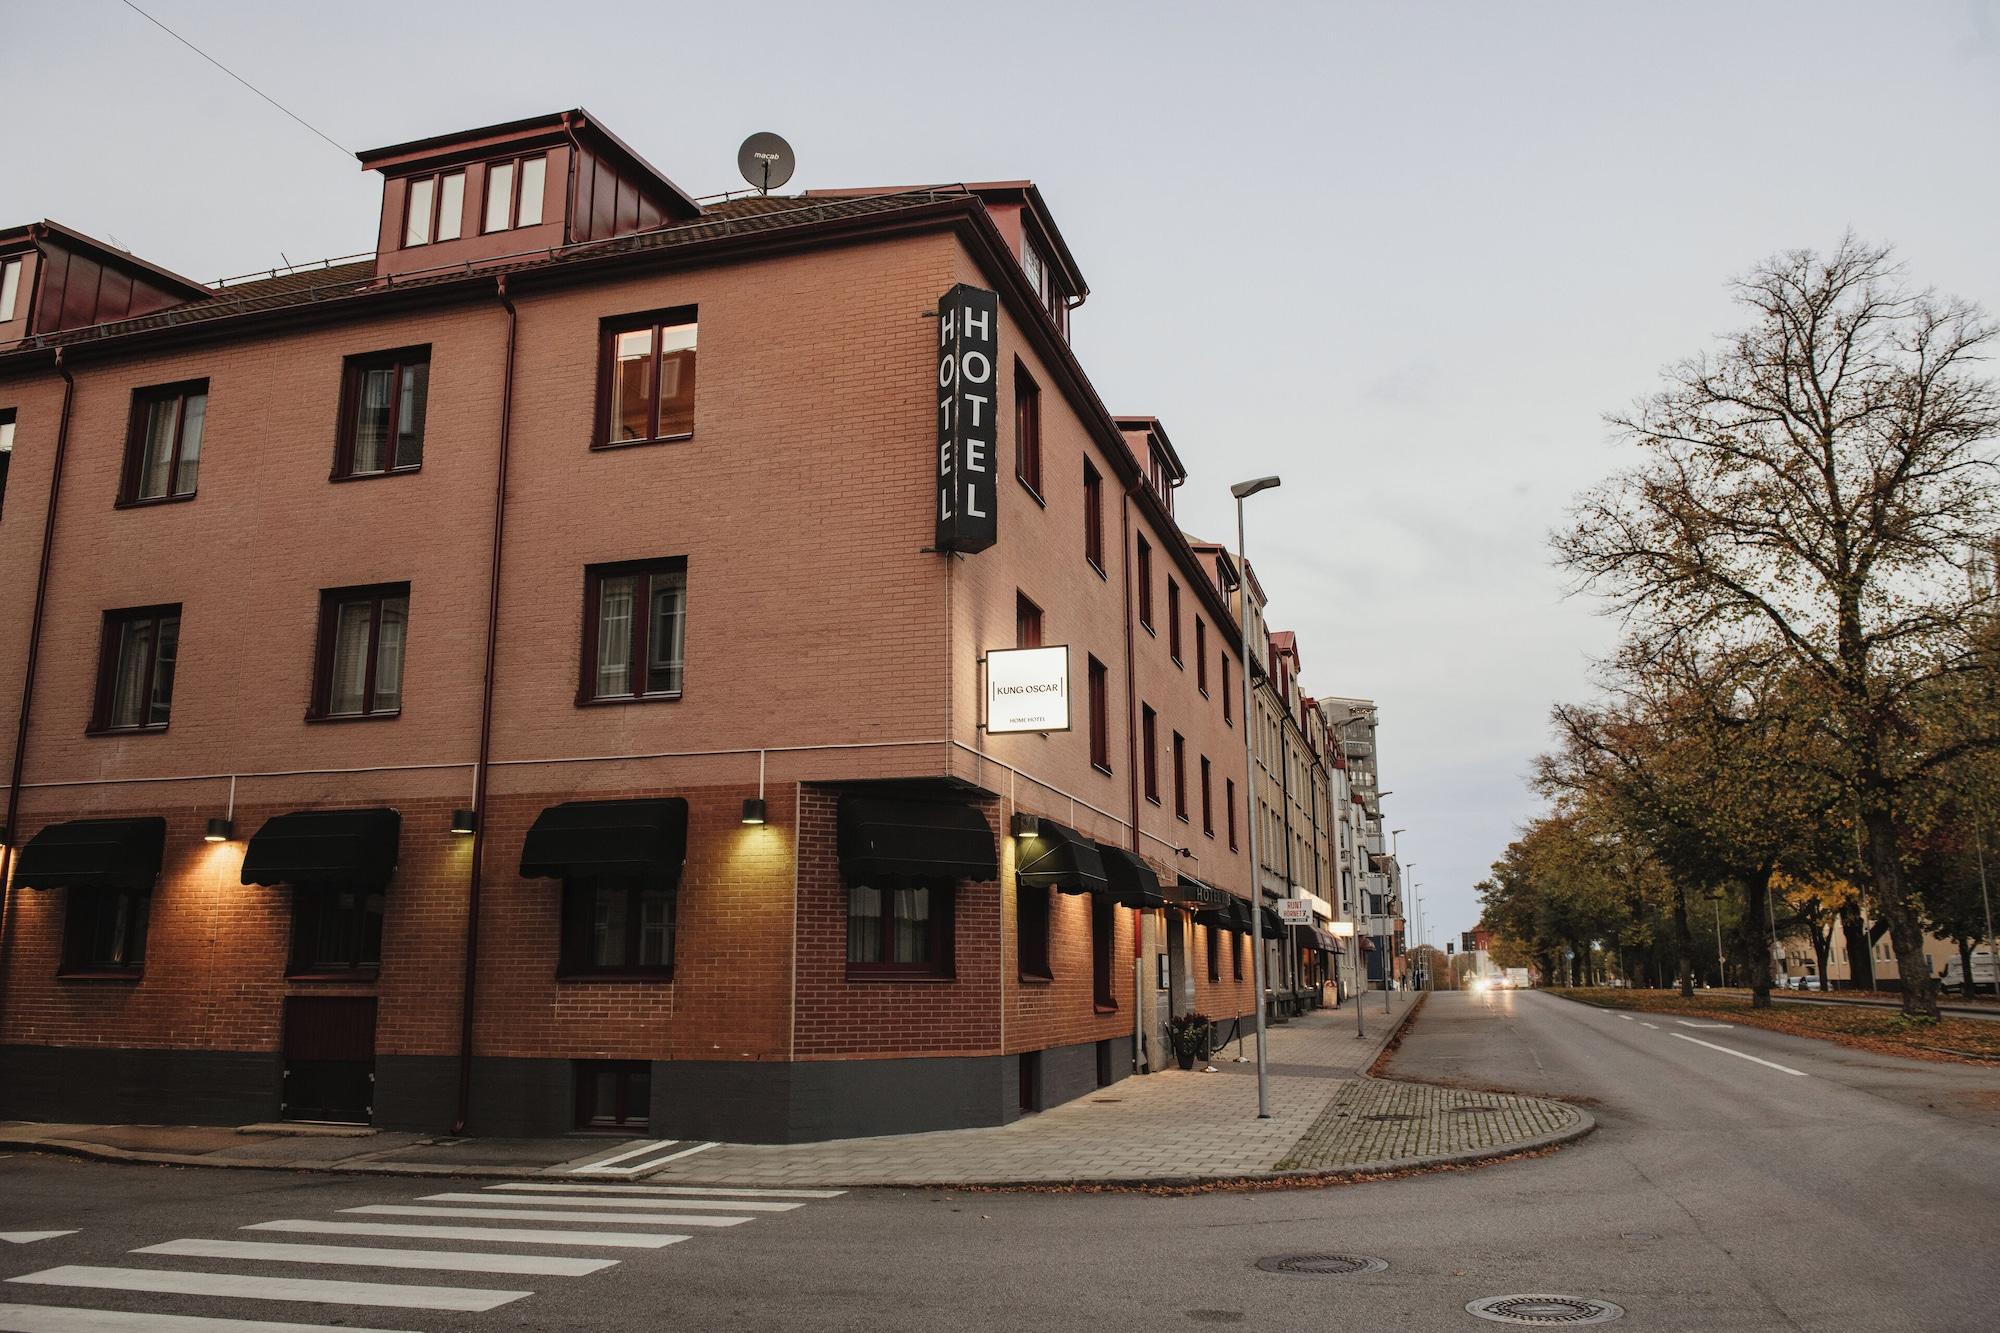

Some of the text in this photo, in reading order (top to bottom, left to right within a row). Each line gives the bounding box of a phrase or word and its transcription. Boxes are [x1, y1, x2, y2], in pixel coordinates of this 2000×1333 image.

[754, 152, 779, 160] macab
[939, 308, 955, 522] HOTEL
[961, 306, 991, 519] HOTEL
[997, 684, 1058, 695] KUNG OSCAR
